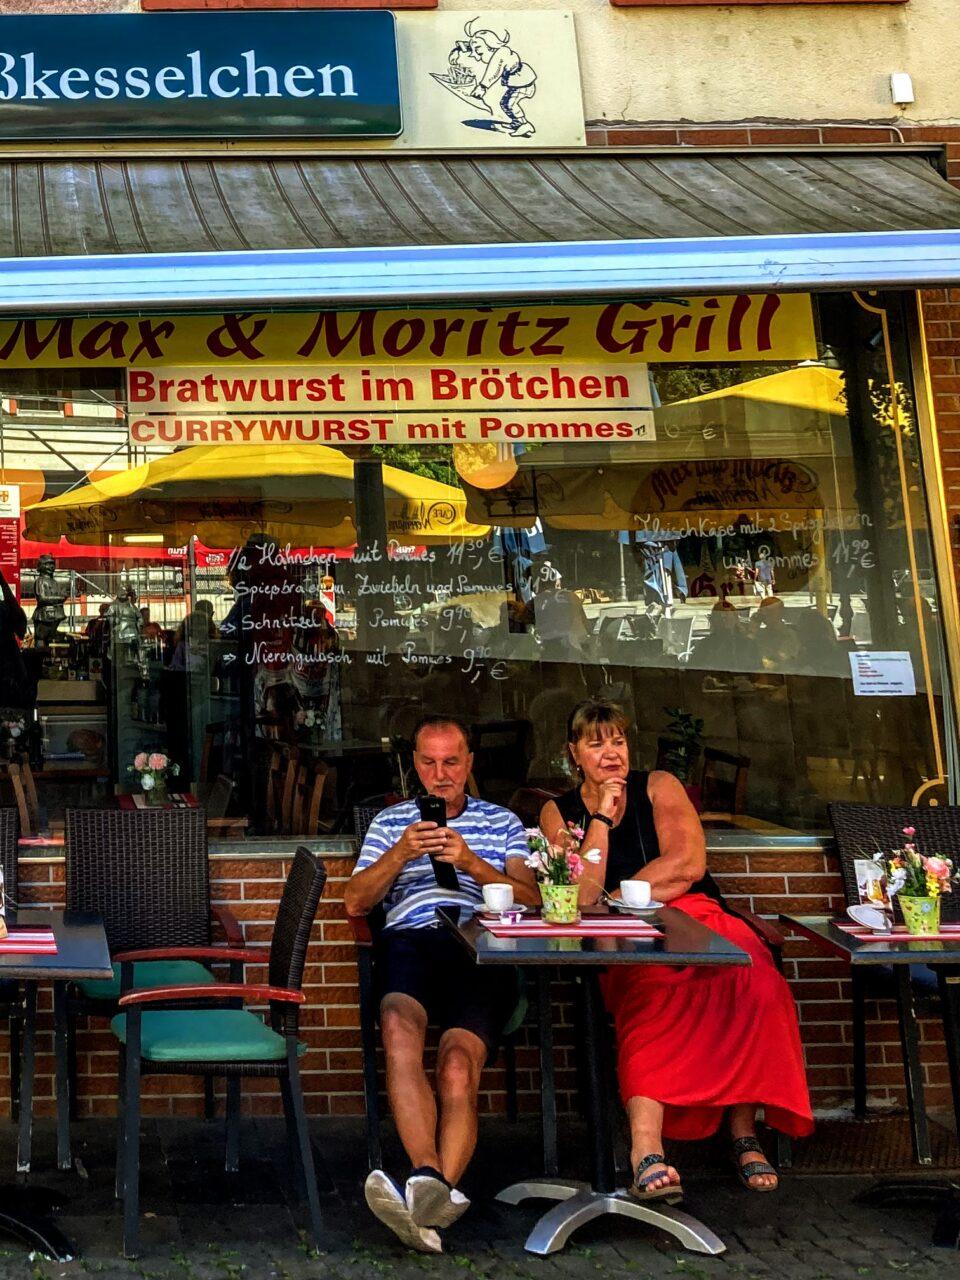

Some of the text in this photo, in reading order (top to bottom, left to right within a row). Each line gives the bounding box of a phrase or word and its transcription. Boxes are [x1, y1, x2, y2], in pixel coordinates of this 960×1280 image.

[206, 313, 268, 360] &
[297, 308, 571, 358] Moritz
[595, 294, 782, 355] Grill
[128, 367, 630, 403] Bratwurst im Brötchen
[130, 417, 634, 442] CURRYWURST mit Pommes
[255, 542, 339, 570] Hähnchen
[241, 605, 321, 631] Schnitzel
[490, 661, 509, 680] €
